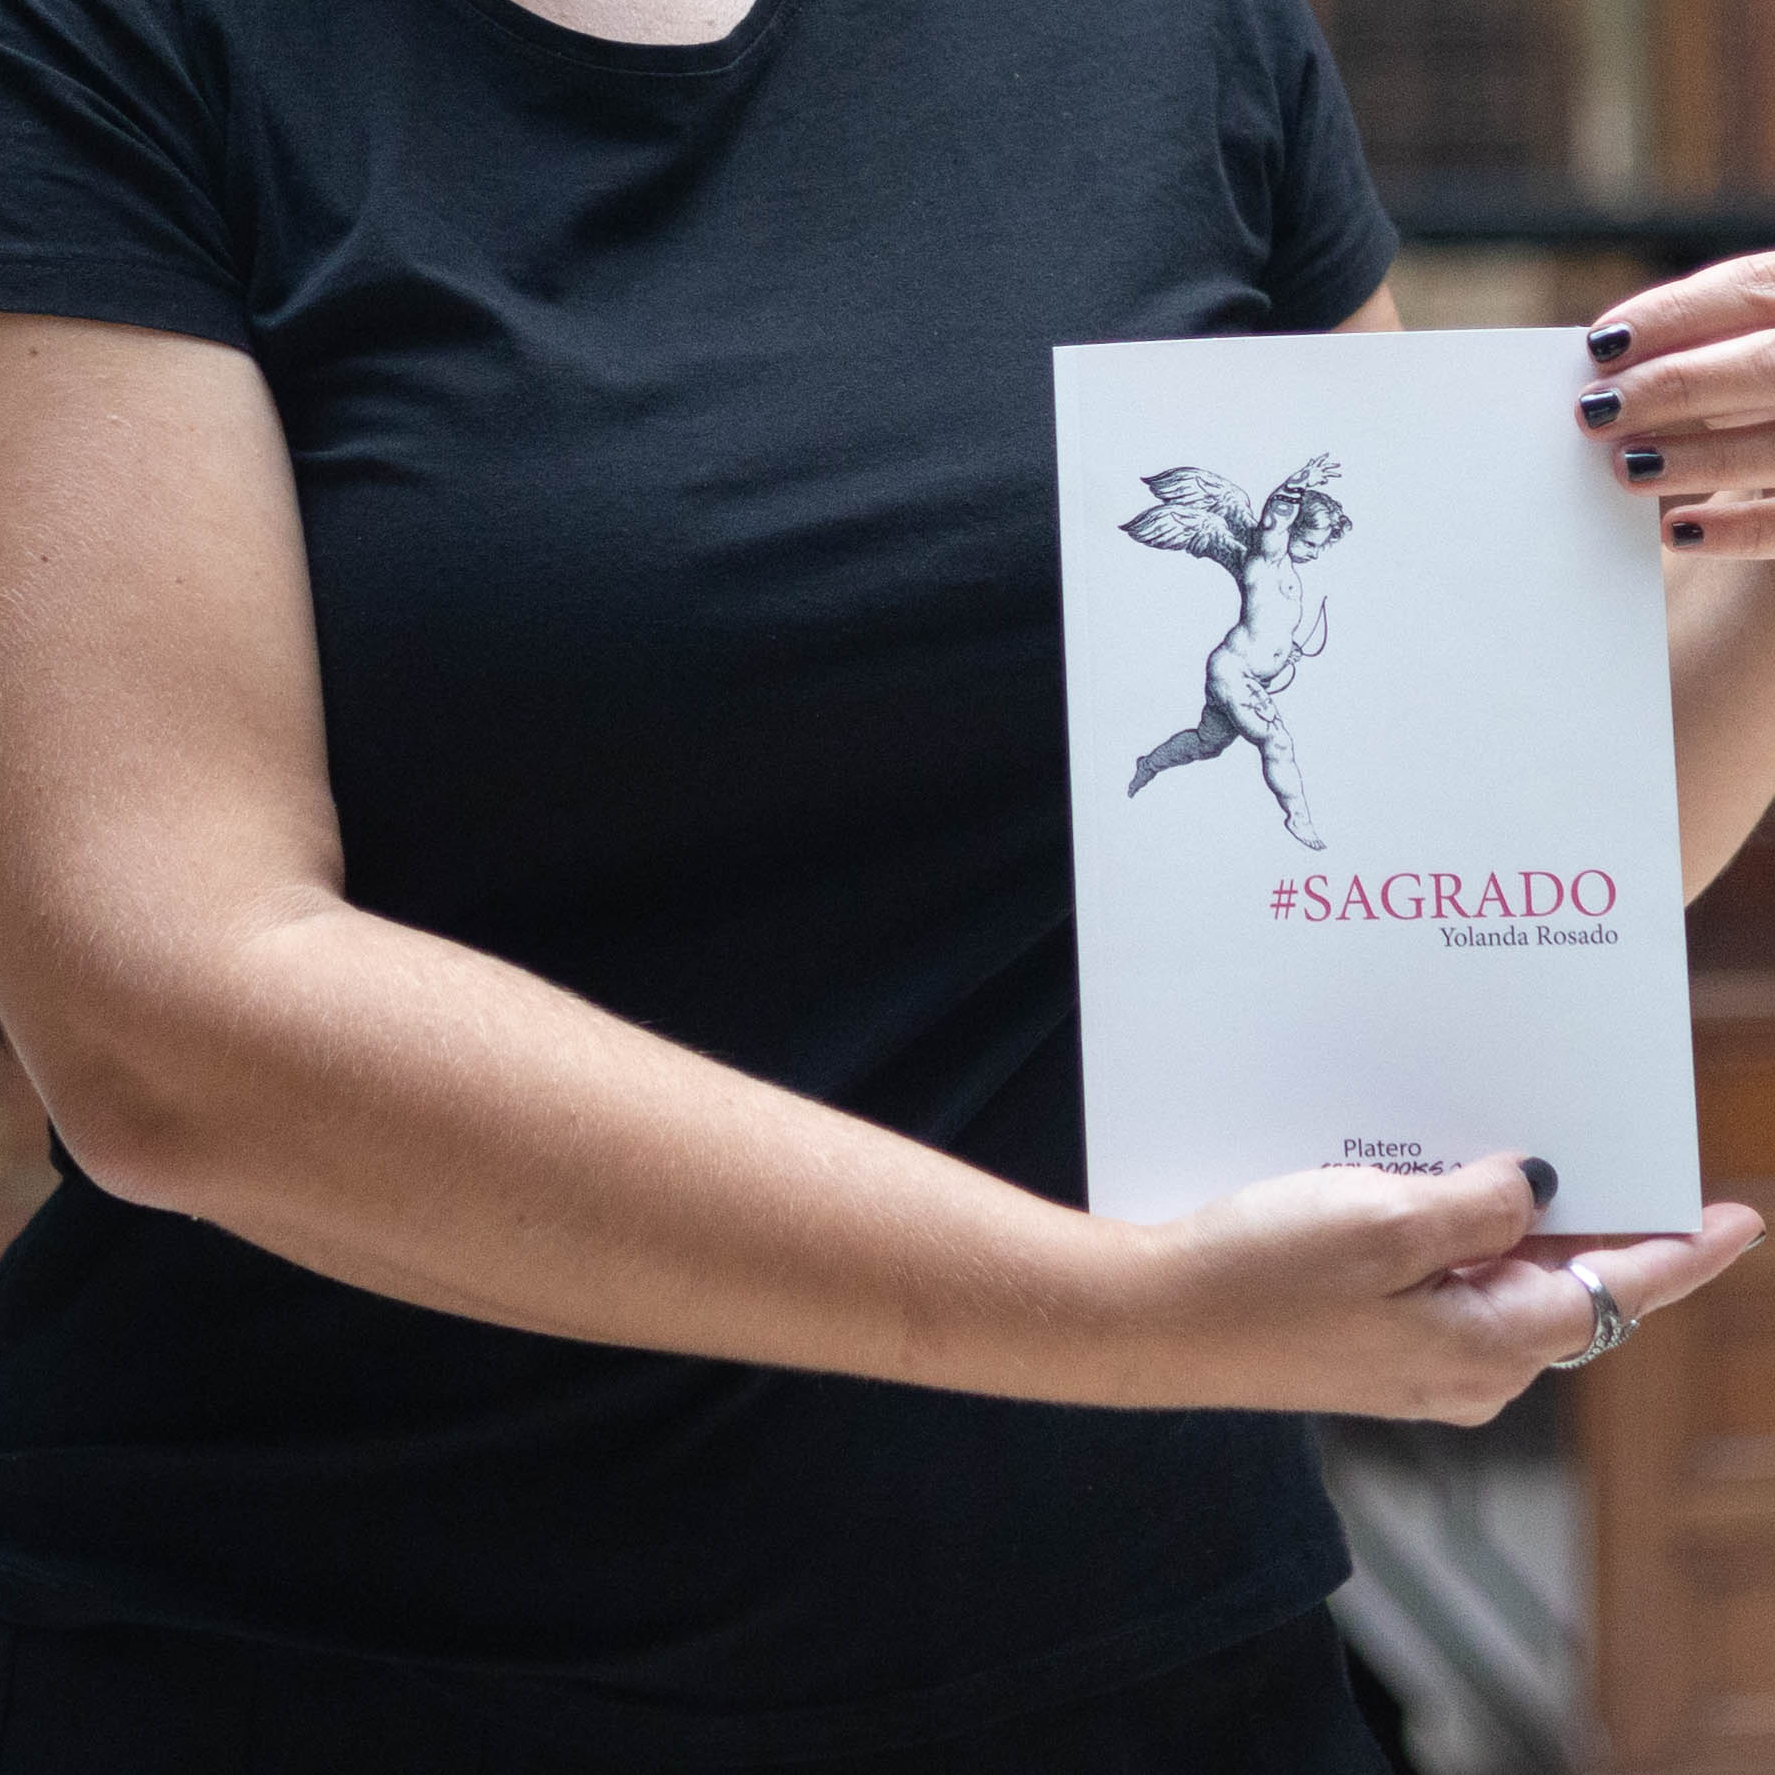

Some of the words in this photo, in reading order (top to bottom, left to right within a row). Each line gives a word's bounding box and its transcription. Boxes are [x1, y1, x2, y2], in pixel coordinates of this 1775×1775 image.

[1270, 869, 1617, 921] #SAGRADO
[1440, 926, 1528, 947] Yolanda
[1536, 923, 1618, 945] Rosado
[1343, 1138, 1422, 1158] Platero
